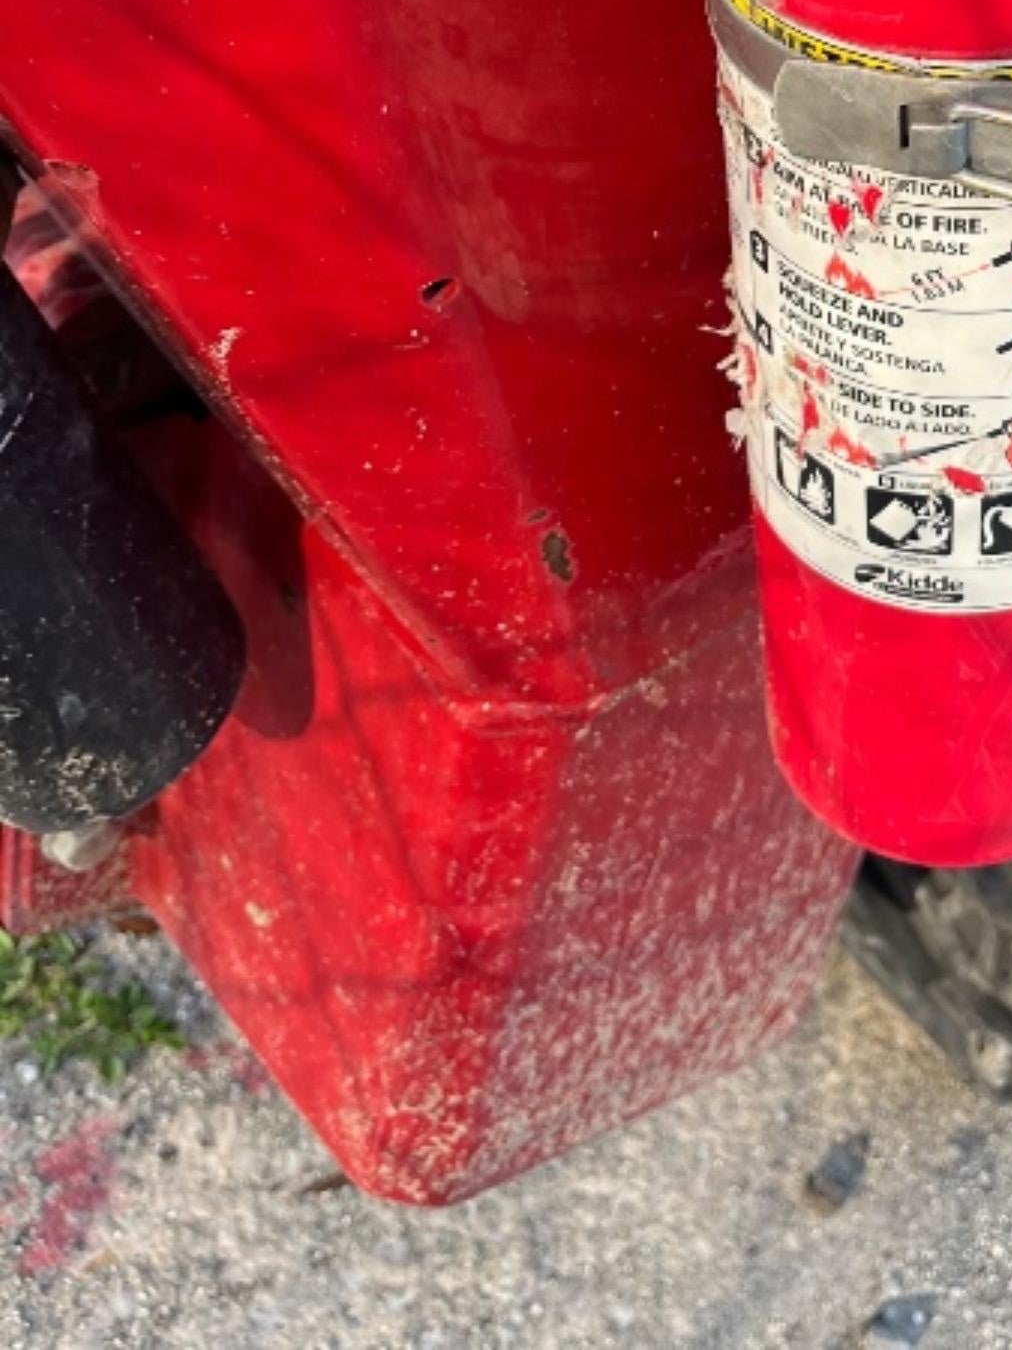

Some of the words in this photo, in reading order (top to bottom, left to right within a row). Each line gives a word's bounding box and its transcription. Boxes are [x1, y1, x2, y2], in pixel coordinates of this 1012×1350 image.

[897, 212, 927, 230] OF
[933, 216, 988, 234] FIRE.
[893, 236, 915, 251] LA
[921, 239, 970, 255] BASE
[925, 267, 944, 284] FT
[777, 260, 853, 315] SQUEEZE
[858, 303, 904, 328] AND
[779, 282, 822, 318] HOLD
[828, 312, 892, 346] LEVER.
[851, 344, 945, 374] SOSTENGA
[838, 382, 883, 409] SIDE
[890, 398, 916, 415] TO
[921, 403, 976, 419] SIDE.
[854, 409, 901, 430] LADO
[887, 566, 964, 591] Kidde
